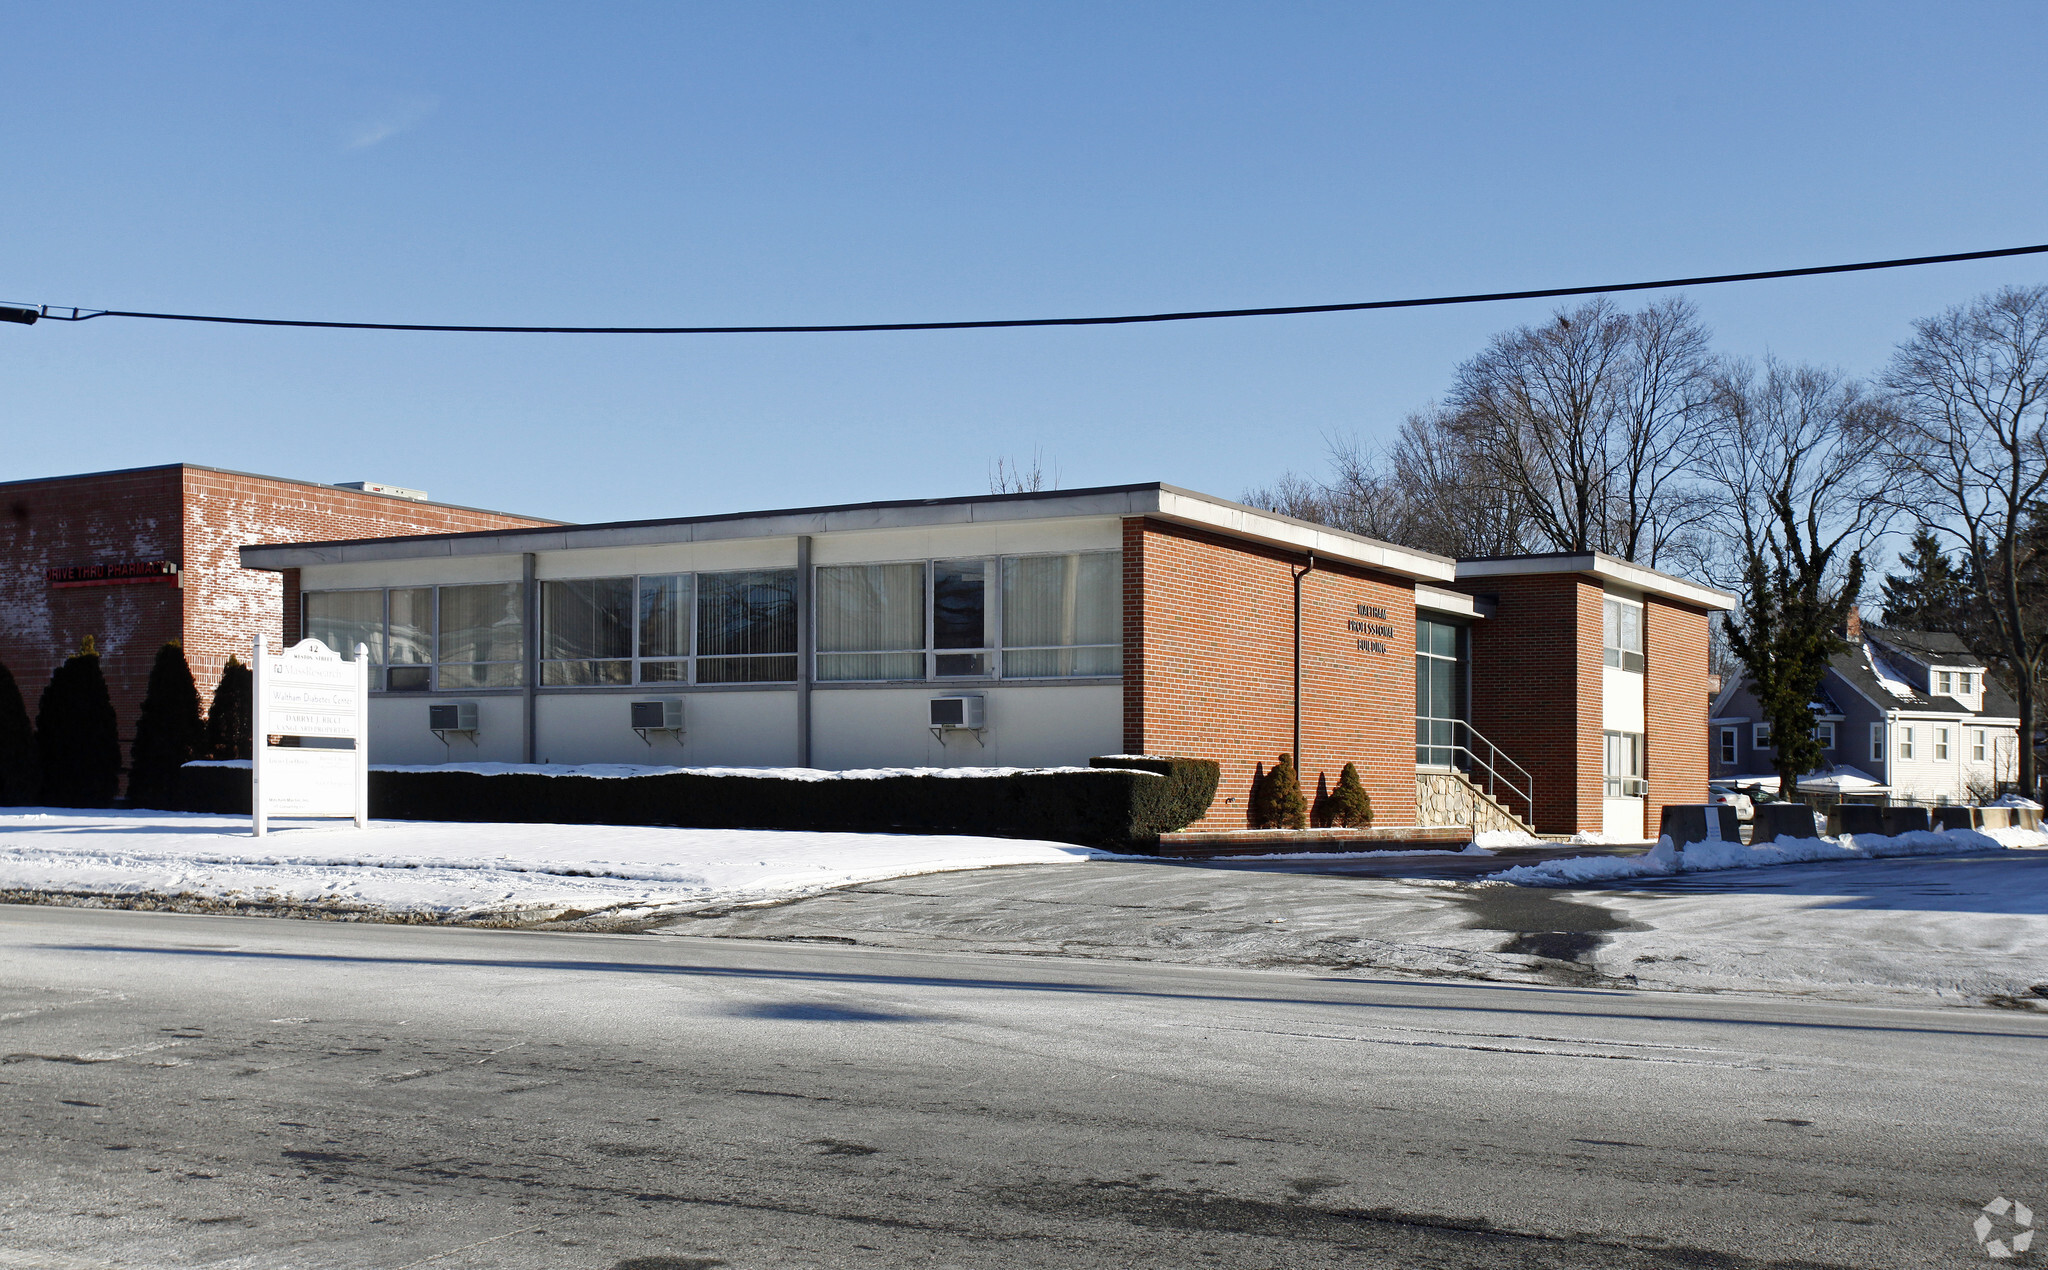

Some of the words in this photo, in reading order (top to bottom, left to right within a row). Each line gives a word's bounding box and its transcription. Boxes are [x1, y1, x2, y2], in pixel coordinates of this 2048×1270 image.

[46, 567, 74, 580] DRIVE
[78, 564, 104, 578] THRU
[108, 561, 168, 577] PHARMACY
[1357, 604, 1387, 620] WALTHAM
[1348, 620, 1394, 638] PROFESSIONAL
[309, 645, 319, 653] 42
[1357, 639, 1387, 654] BUILDING
[273, 691, 302, 702] Waltham
[303, 693, 331, 704] Diabetes
[332, 694, 353, 705] Center
